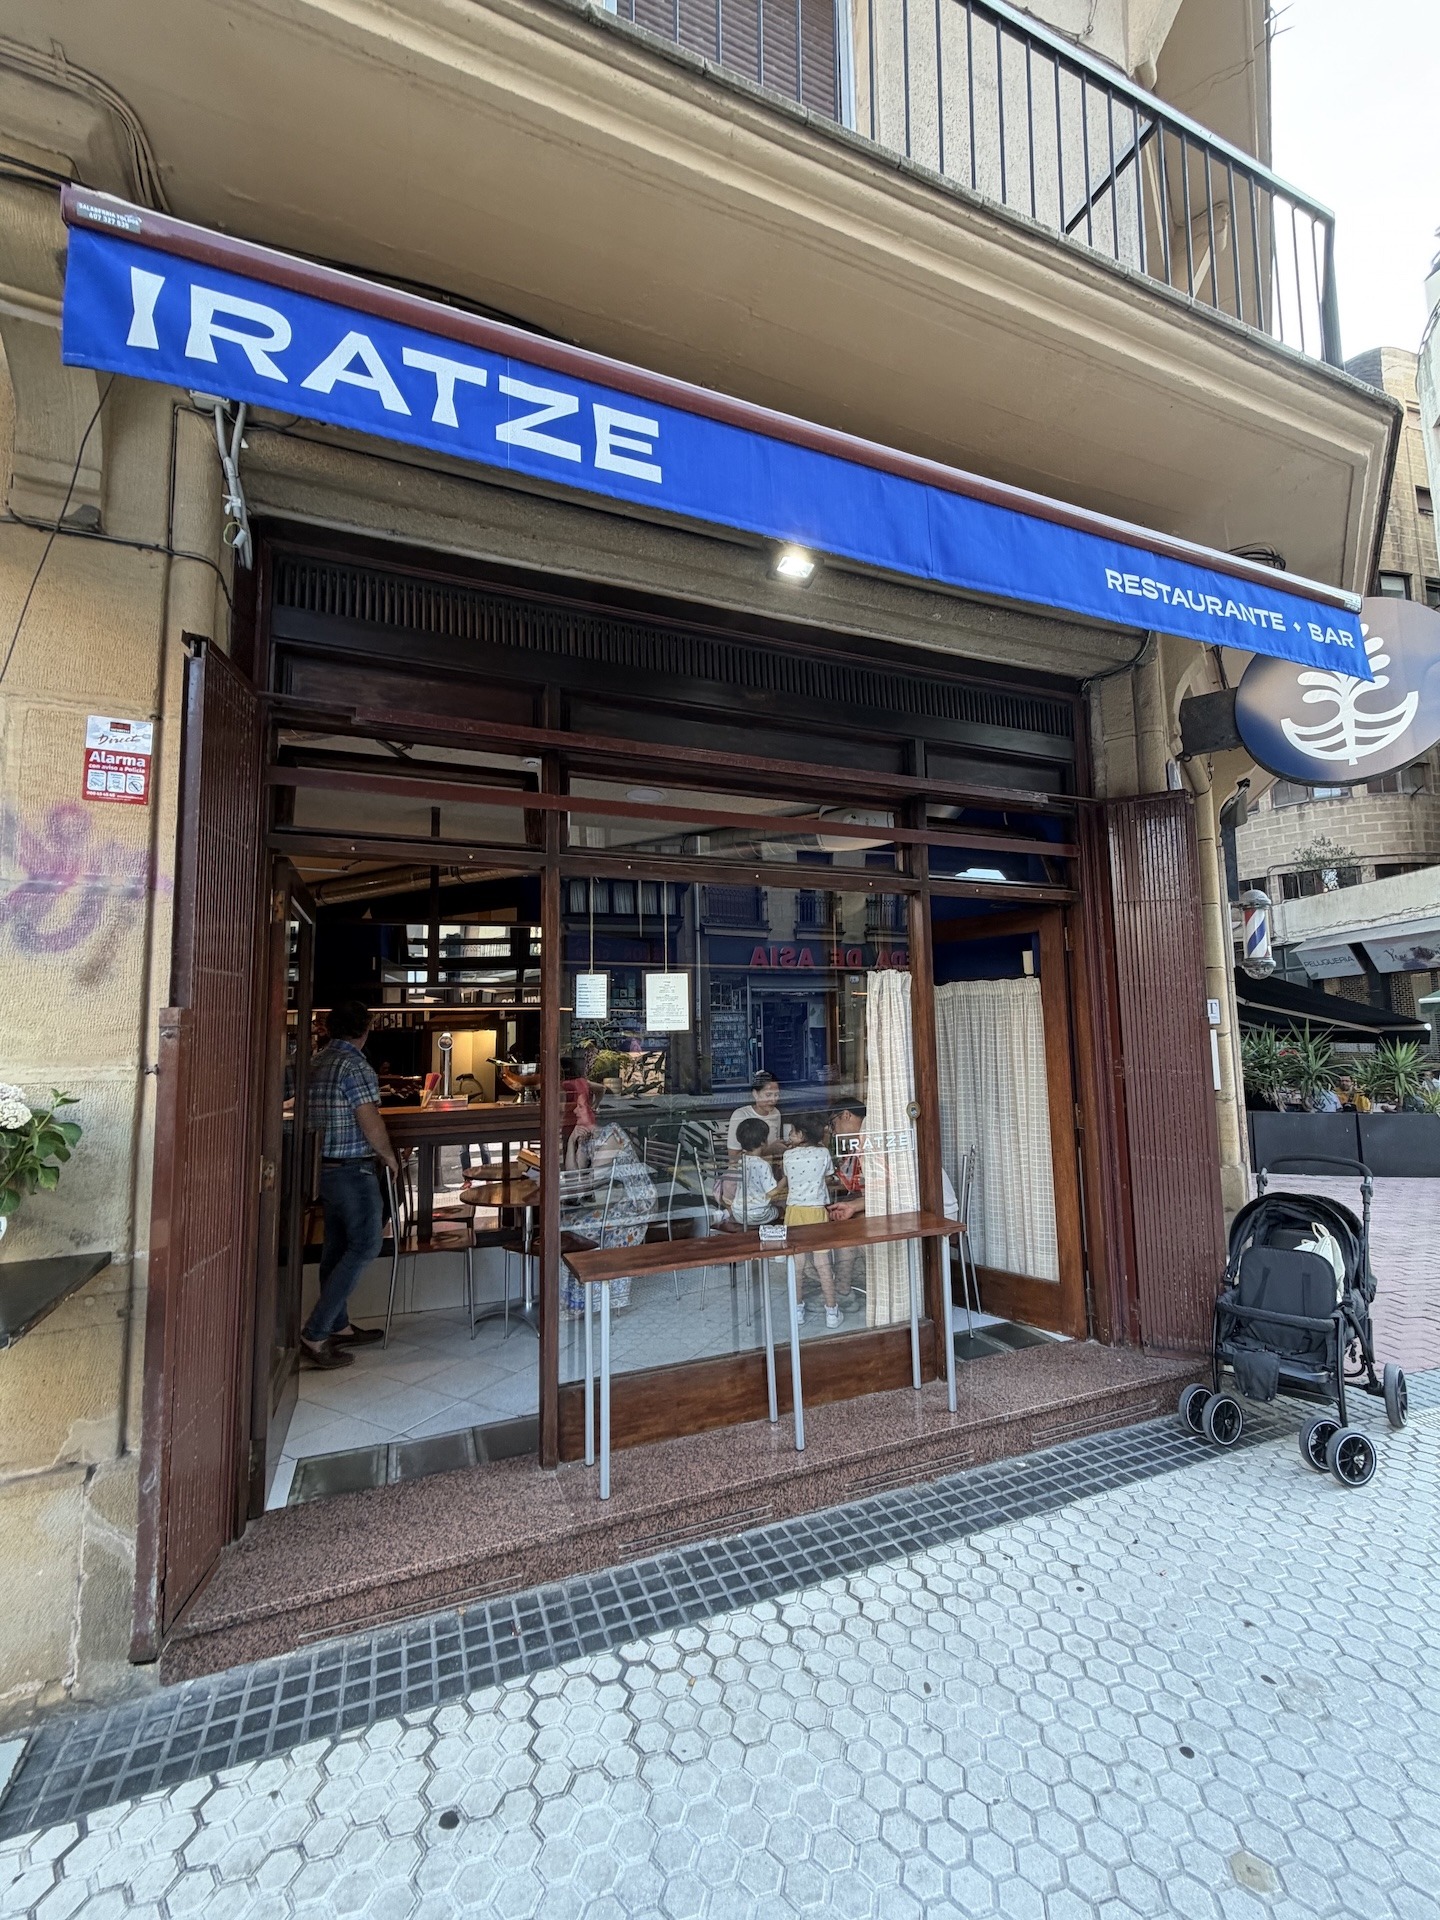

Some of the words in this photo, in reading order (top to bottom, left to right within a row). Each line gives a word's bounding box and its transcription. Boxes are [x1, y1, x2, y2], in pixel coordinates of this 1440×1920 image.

[126, 265, 663, 484] IRATZE
[1104, 567, 1287, 632] RESTAURANTE
[1307, 622, 1356, 649] BAR
[89, 751, 146, 767] Alarma
[841, 1135, 909, 1152] IRATZE
